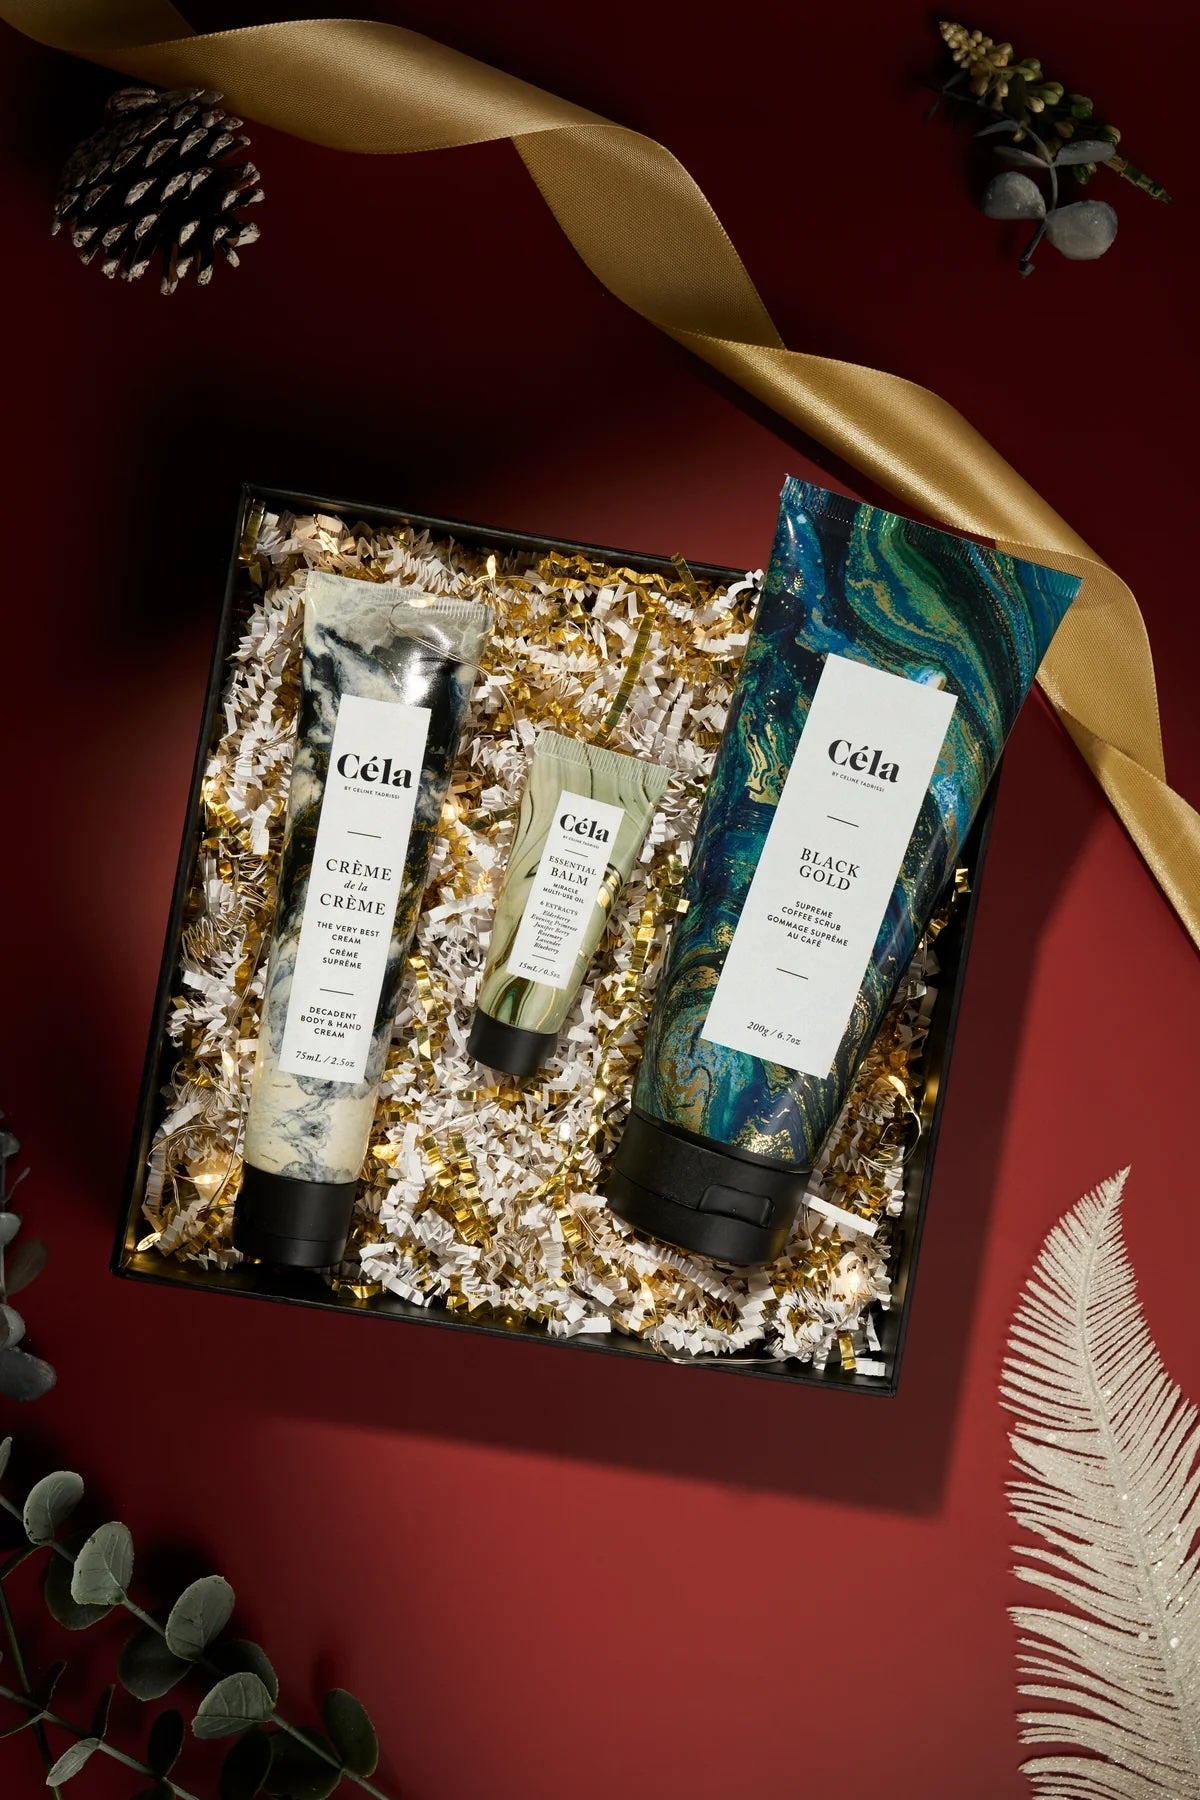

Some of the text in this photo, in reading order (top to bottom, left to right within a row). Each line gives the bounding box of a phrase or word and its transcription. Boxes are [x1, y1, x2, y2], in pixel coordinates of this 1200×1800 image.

[828, 739, 900, 783] Céla
[337, 753, 413, 789] Céla
[559, 813, 610, 843] Céla
[326, 858, 392, 881] CRÈME
[549, 855, 597, 876] ESSENTIAL
[800, 847, 860, 878] BLACK
[550, 867, 589, 886] BALM
[799, 864, 851, 891] GOLD
[343, 880, 368, 892] de la
[553, 883, 579, 895] MIRACLE
[542, 887, 584, 904] MULTI-USE OIL
[320, 893, 386, 916] CRÈME
[545, 902, 578, 916] EXTRACTS
[795, 901, 833, 919] SUPREME
[530, 913, 553, 926] Evening
[542, 910, 571, 924] Elderberry
[767, 914, 809, 934] GOMMAGE
[781, 906, 841, 931] COFFEE SCRUB
[317, 921, 380, 938] THE VERY BEST
[533, 922, 570, 937] Juniper Berry
[537, 929, 563, 941] Rosemary
[331, 934, 361, 945] CREAM
[535, 936, 561, 947] Lavender
[787, 931, 822, 948] AU CAFÉ
[533, 942, 560, 955] Blueberry
[309, 1006, 357, 1020] DECADENT
[300, 1015, 325, 1025] BODY
[336, 1021, 362, 1031] HAND
[314, 1027, 345, 1038] CREAM
[746, 1021, 770, 1037] 200g
[777, 1031, 801, 1046] 6.7oz
[295, 1050, 322, 1063] 75mL
[330, 1057, 355, 1068] 2.5oz
